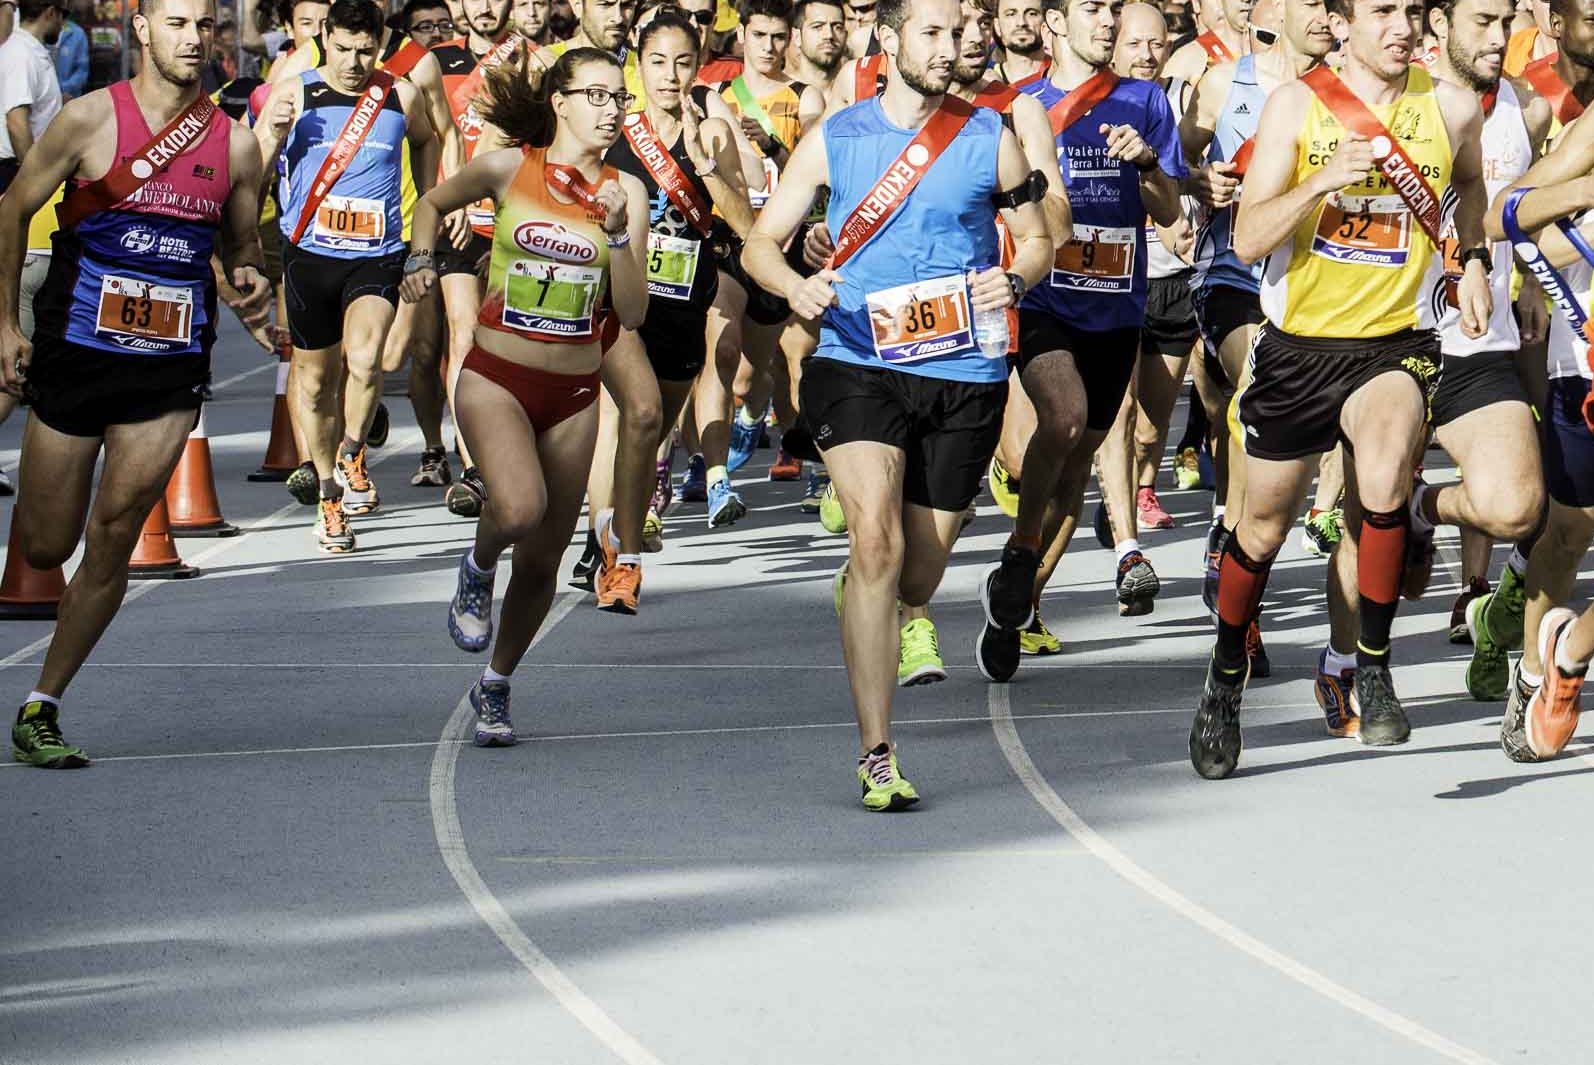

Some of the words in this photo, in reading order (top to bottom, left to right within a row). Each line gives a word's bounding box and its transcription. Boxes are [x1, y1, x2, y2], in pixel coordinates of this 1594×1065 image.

[145, 112, 204, 167] EKIDEN
[344, 97, 379, 145] EKIDEN
[628, 122, 667, 172] EKIDEN
[1068, 158, 1093, 169] Terra
[1103, 158, 1121, 168] Mar
[857, 160, 917, 226] EKIDEN
[1383, 152, 1434, 217] EKIDEN
[328, 209, 357, 232] 101
[1338, 213, 1373, 241] 52
[1397, 211, 1408, 249] 1
[159, 236, 189, 249] HOTEL
[520, 227, 593, 260] Serrano
[646, 249, 664, 274] 5
[1081, 242, 1096, 268] 9
[537, 279, 550, 307] 7
[121, 297, 153, 328] 63
[176, 303, 187, 339] 1
[905, 300, 936, 334] 36
[949, 291, 965, 330] 1
